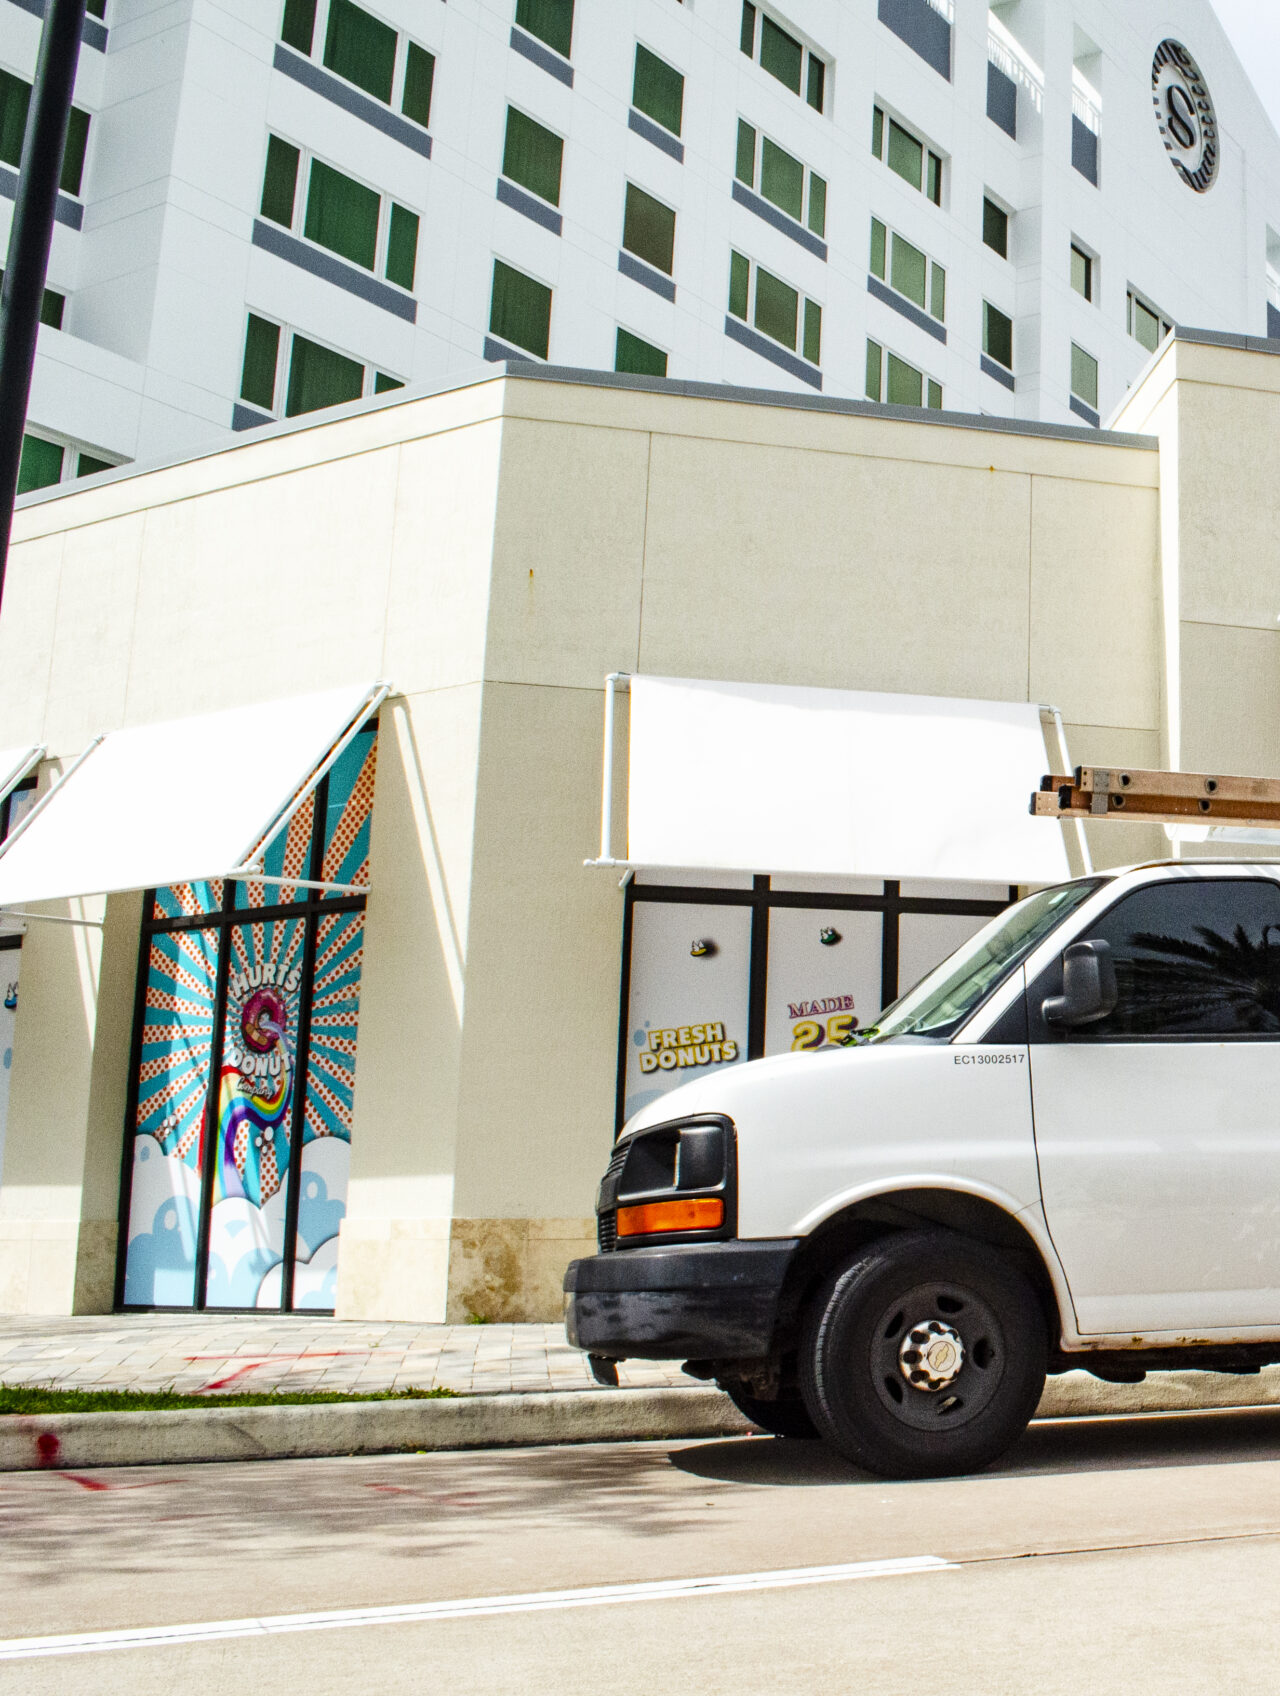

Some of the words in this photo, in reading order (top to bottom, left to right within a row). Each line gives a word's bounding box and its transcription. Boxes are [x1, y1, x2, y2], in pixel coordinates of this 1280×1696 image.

[1167, 84, 1195, 149] S
[232, 962, 301, 999] HURTS
[787, 995, 855, 1019] MADE
[648, 1022, 726, 1051] FRESH
[230, 1046, 292, 1077] DONUT
[640, 1041, 738, 1074] DONUTS
[954, 1054, 1025, 1064] EC13002517
[237, 1076, 274, 1100] Company
